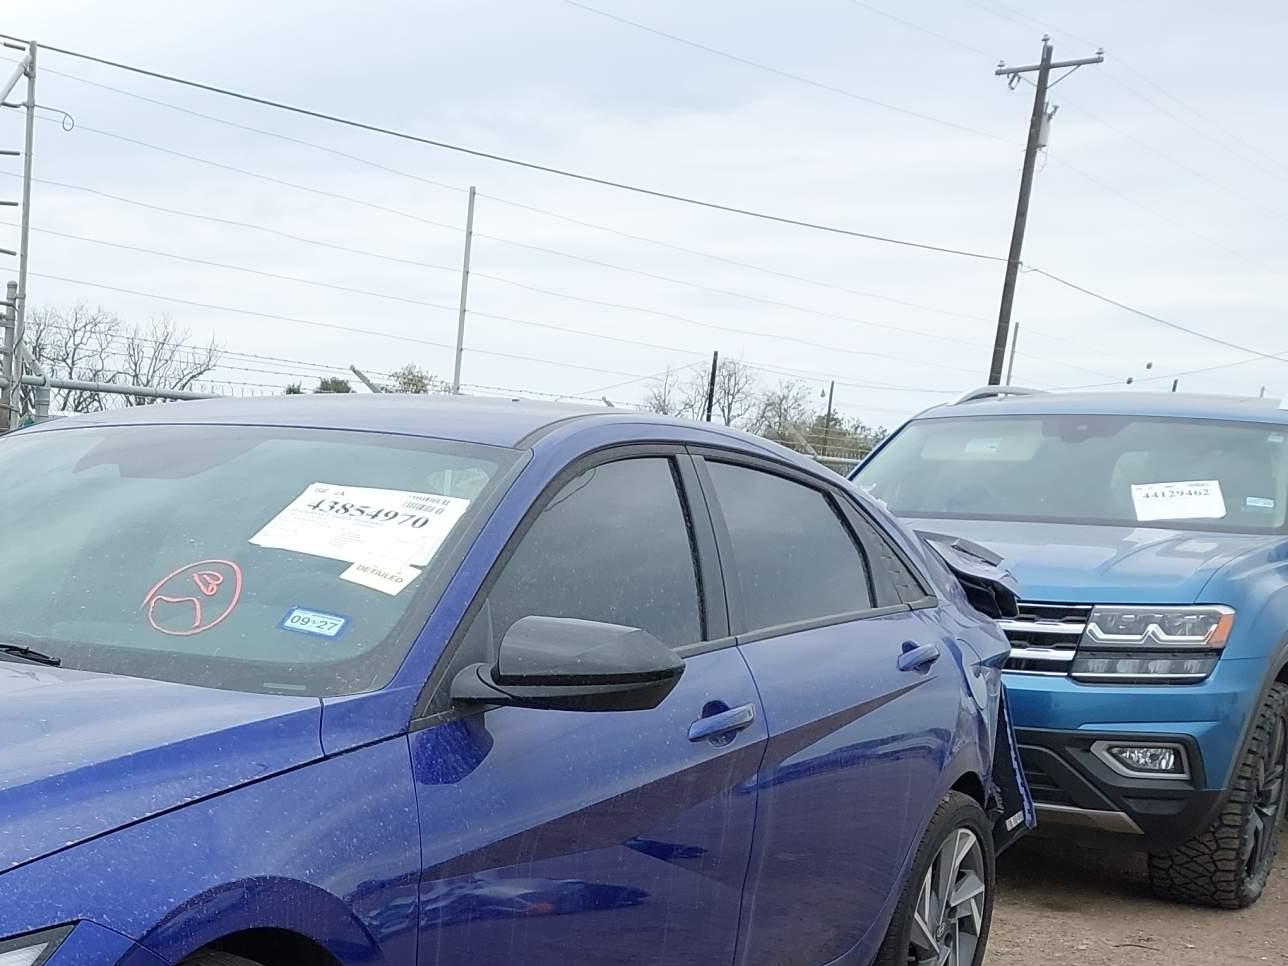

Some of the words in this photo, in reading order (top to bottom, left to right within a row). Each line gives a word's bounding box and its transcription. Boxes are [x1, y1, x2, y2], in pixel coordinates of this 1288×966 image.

[1142, 488, 1211, 500] 44129462
[307, 498, 430, 529] 43854970
[355, 564, 404, 584] DETAILED
[290, 614, 311, 626] 09
[315, 620, 339, 631] 27
